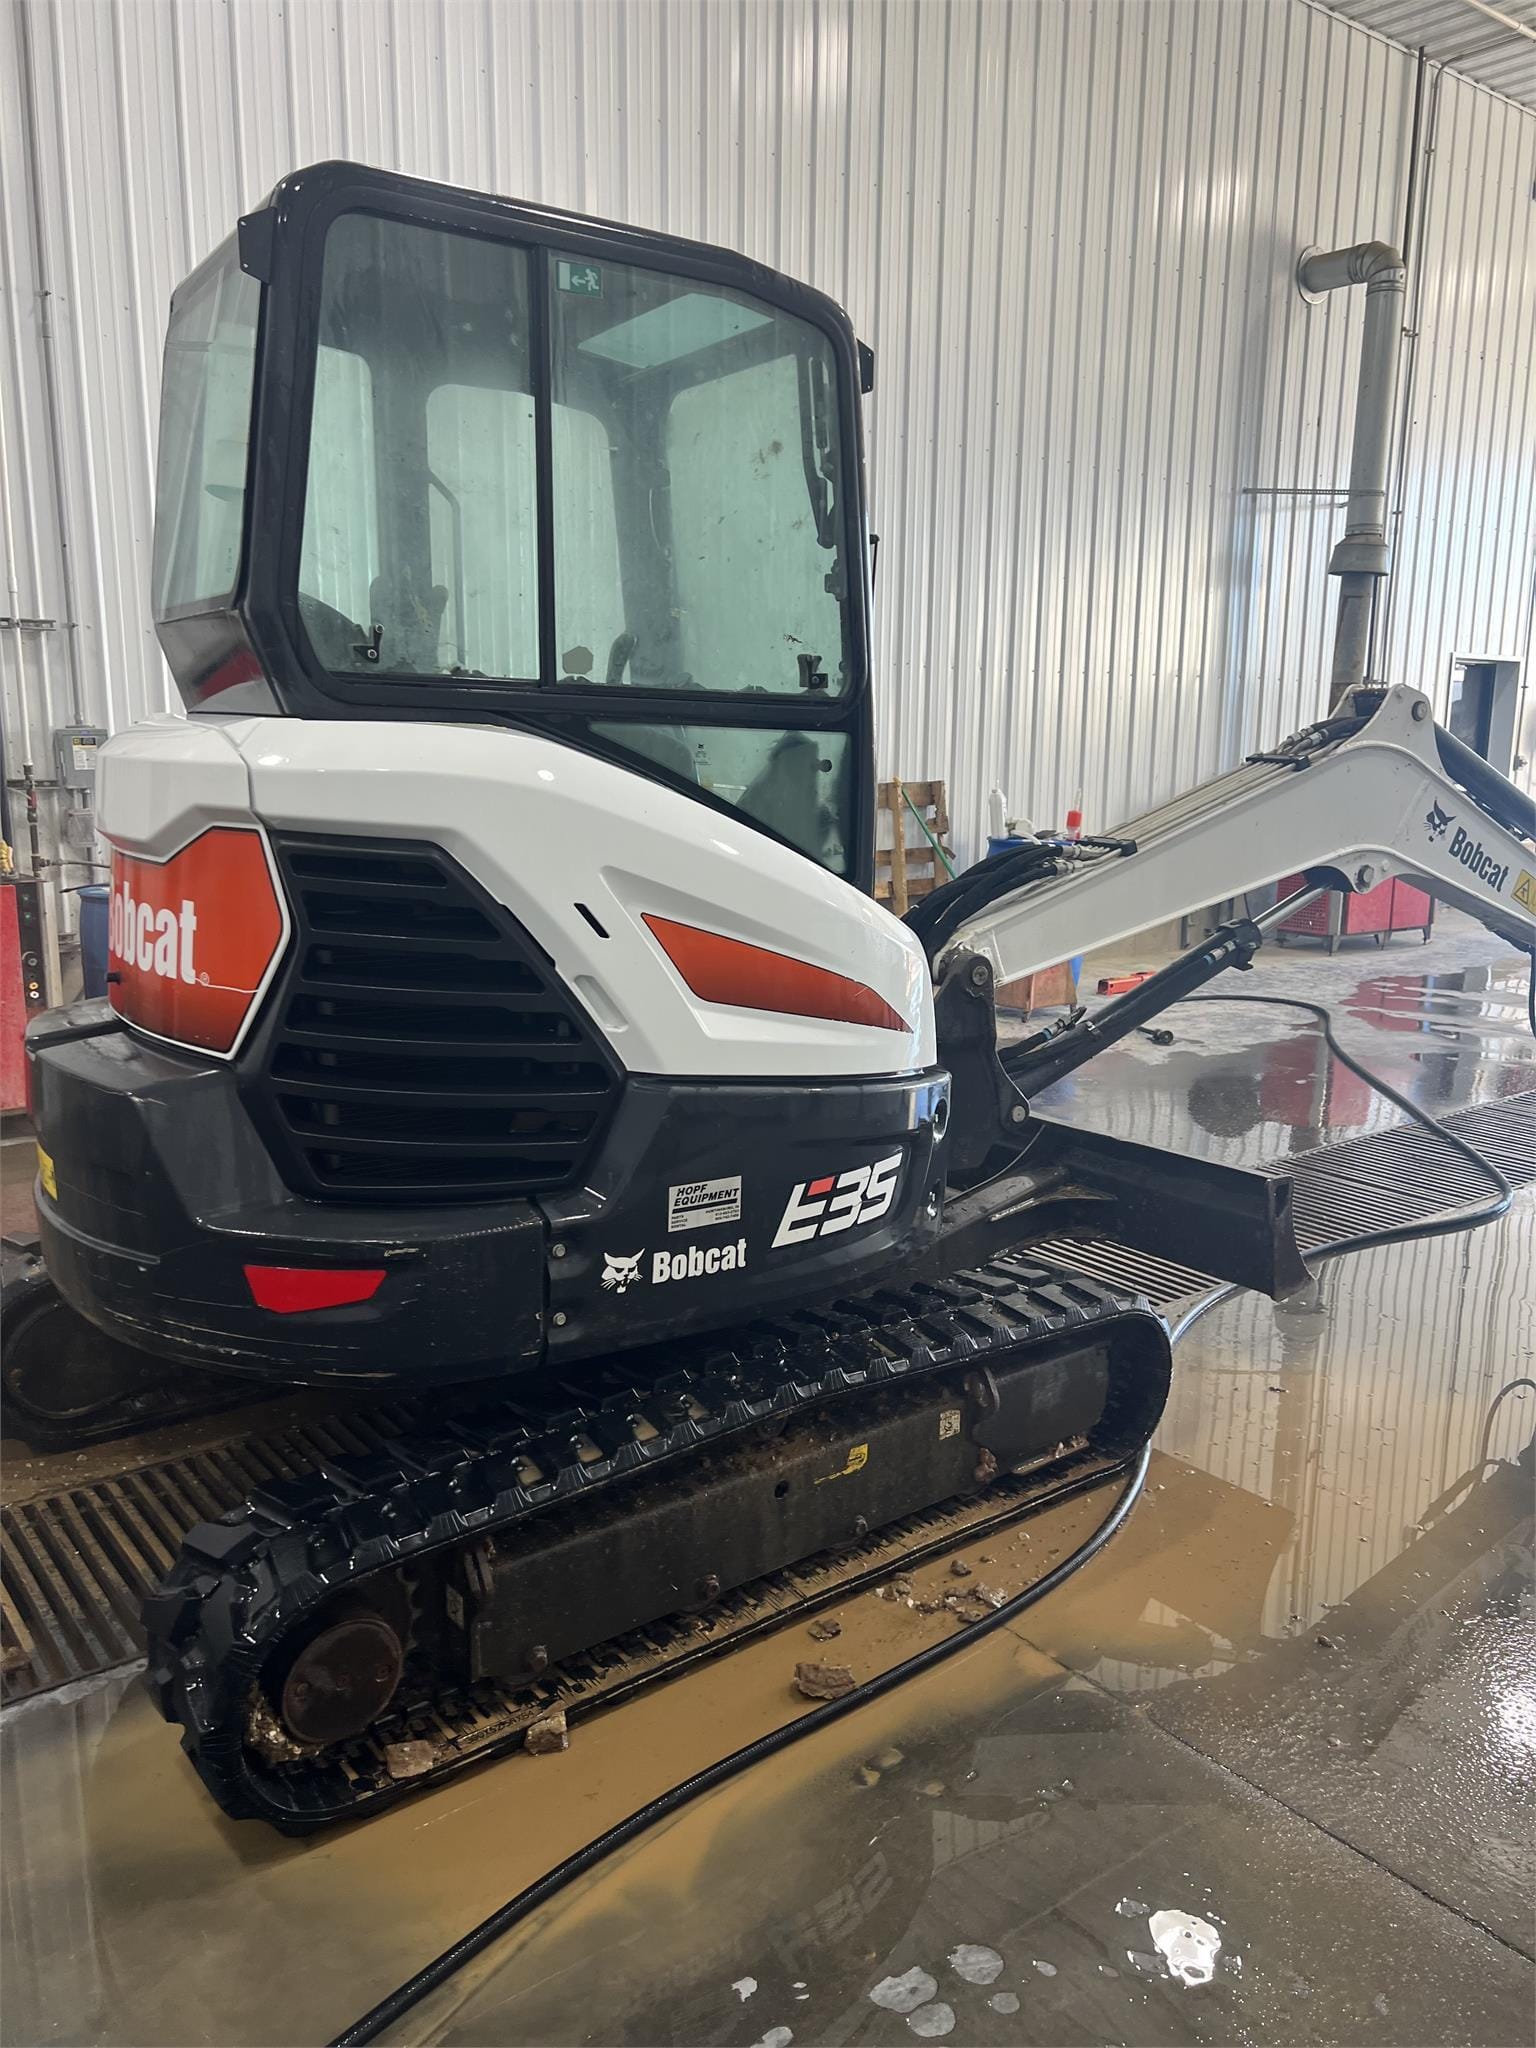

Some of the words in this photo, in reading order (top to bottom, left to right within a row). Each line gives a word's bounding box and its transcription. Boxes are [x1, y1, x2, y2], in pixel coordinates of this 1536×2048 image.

[1448, 826, 1510, 893] Bobcat
[673, 1187, 740, 1207] EQUIPMENT
[676, 1183, 708, 1197] HOPF
[771, 1152, 903, 1249] E35
[652, 1238, 748, 1285] Bobcat
